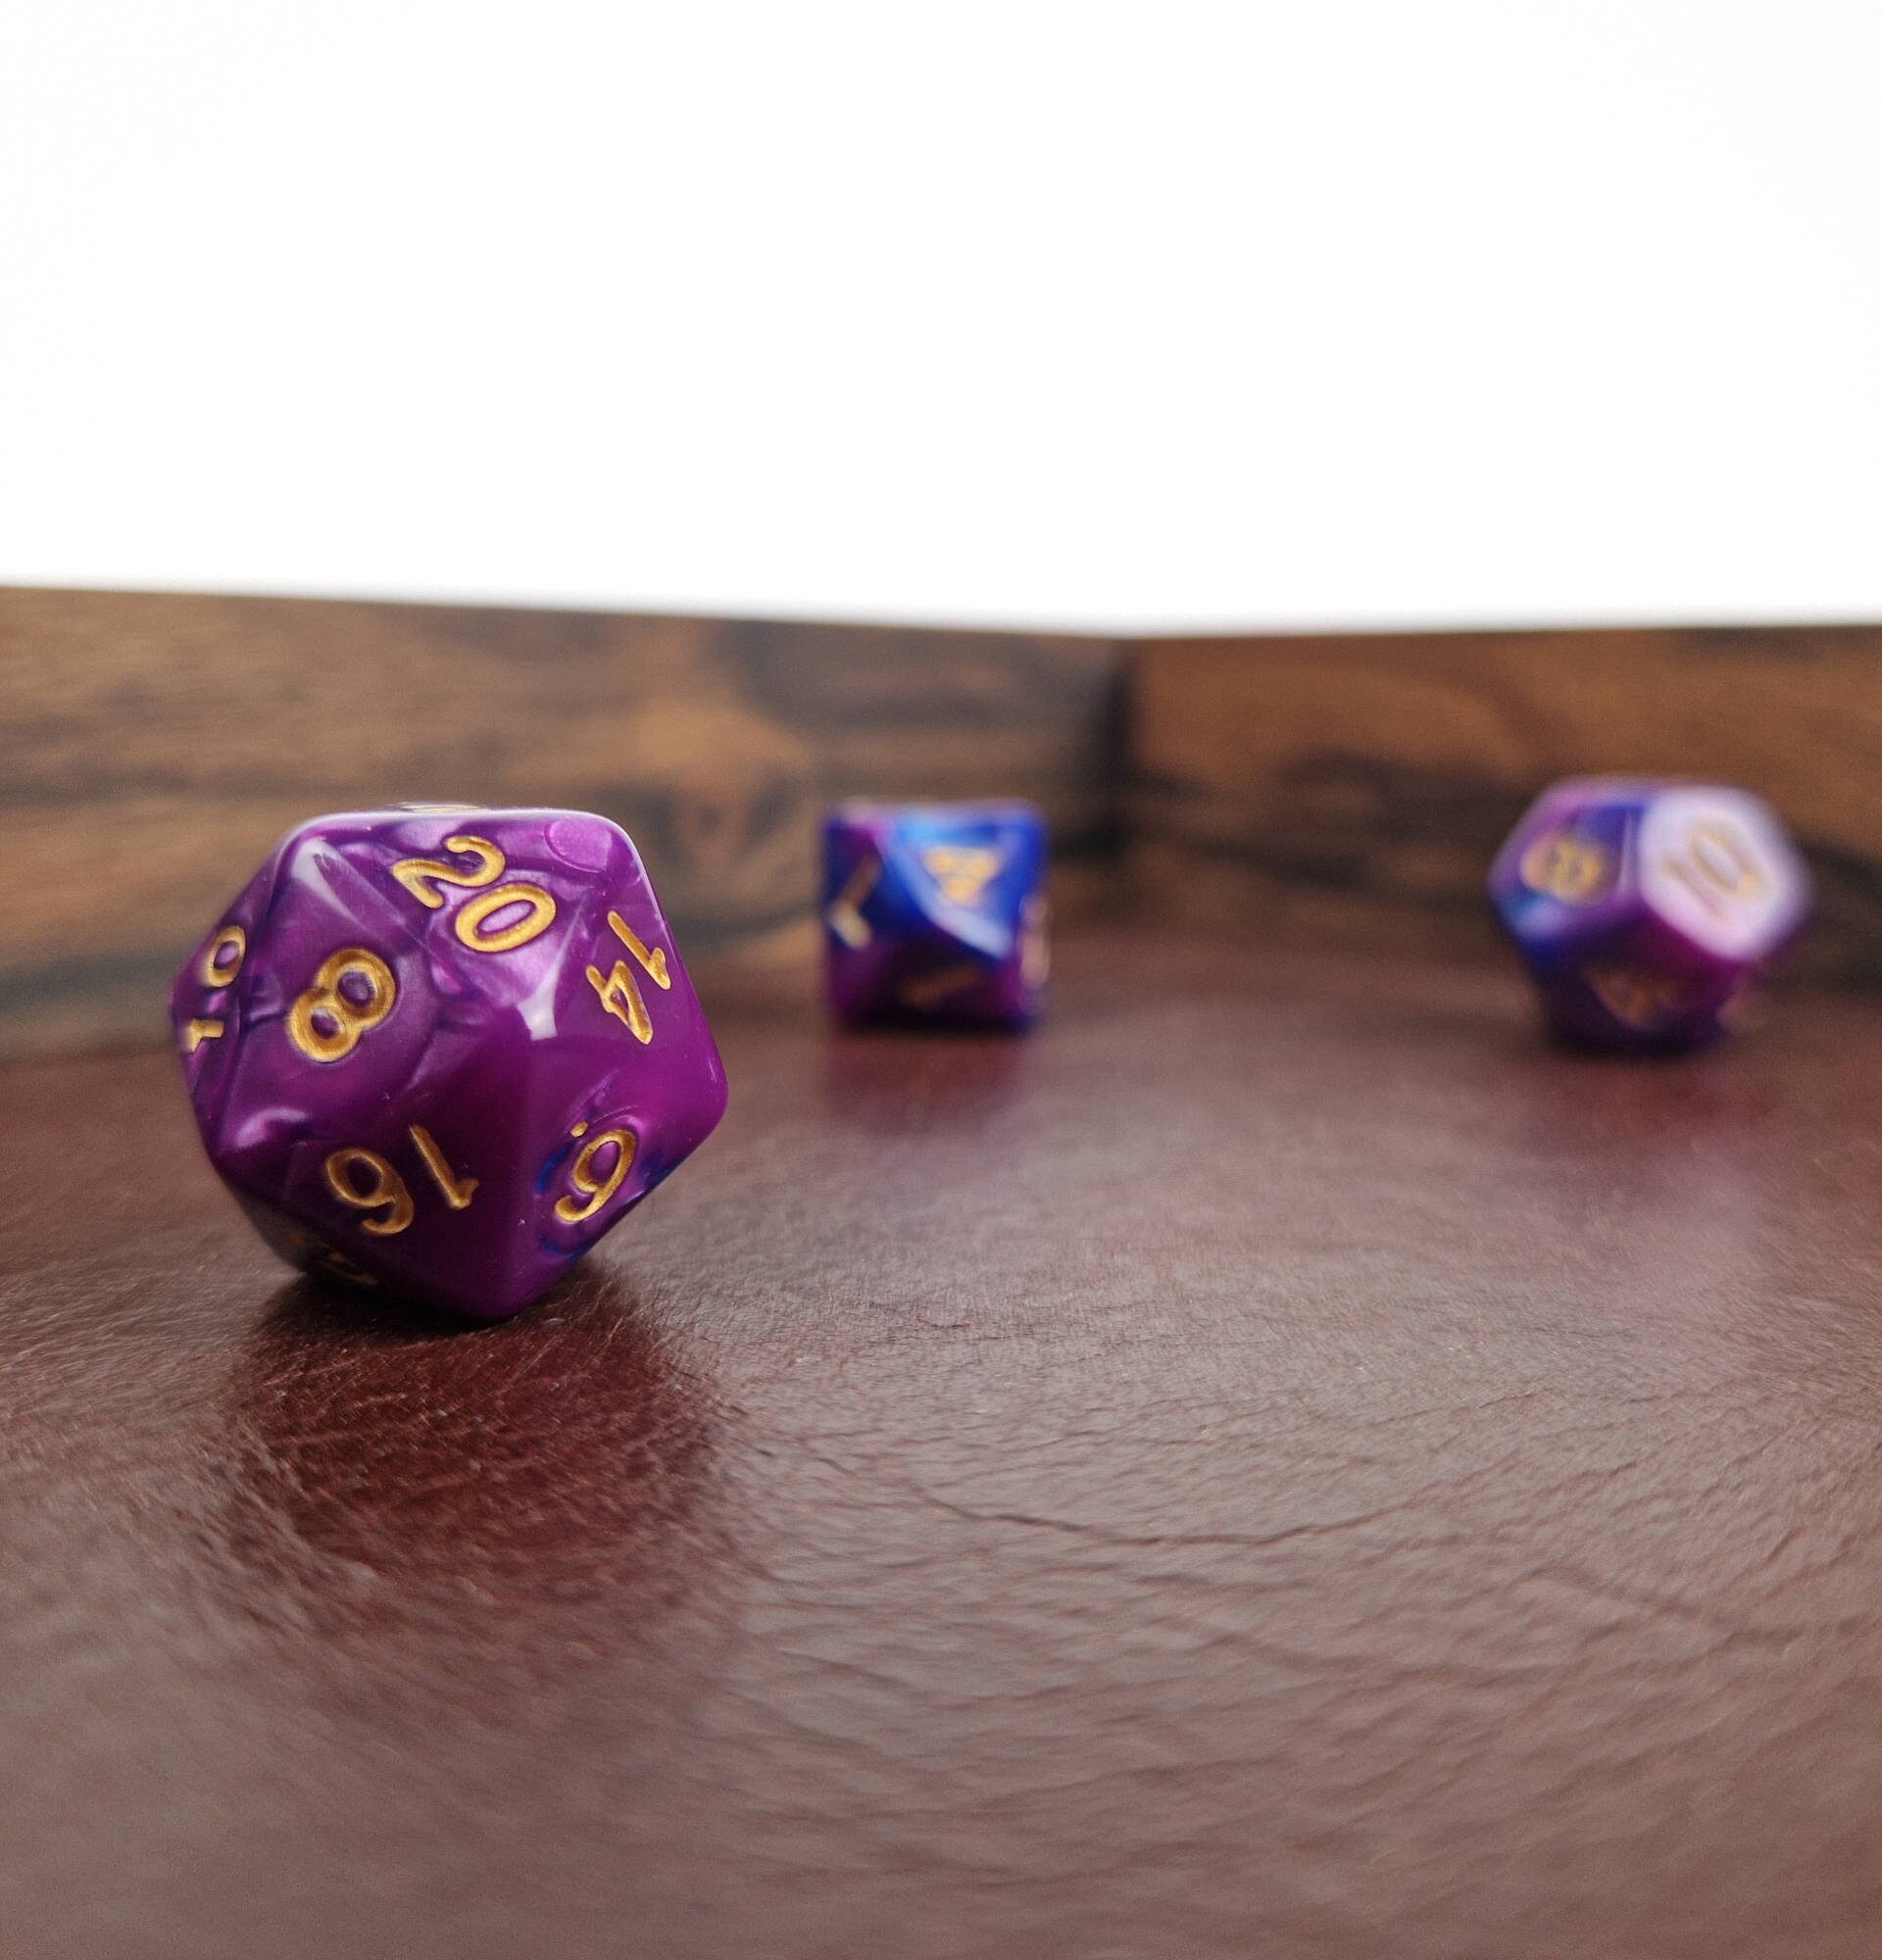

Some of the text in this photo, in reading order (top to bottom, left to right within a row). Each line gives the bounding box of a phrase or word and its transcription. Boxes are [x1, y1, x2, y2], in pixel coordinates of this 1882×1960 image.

[391, 834, 557, 954] 20
[1659, 817, 1760, 918] 10
[180, 924, 247, 1054] 10
[286, 946, 397, 1063] 8
[585, 909, 671, 1045] 14
[324, 1123, 480, 1235] 16
